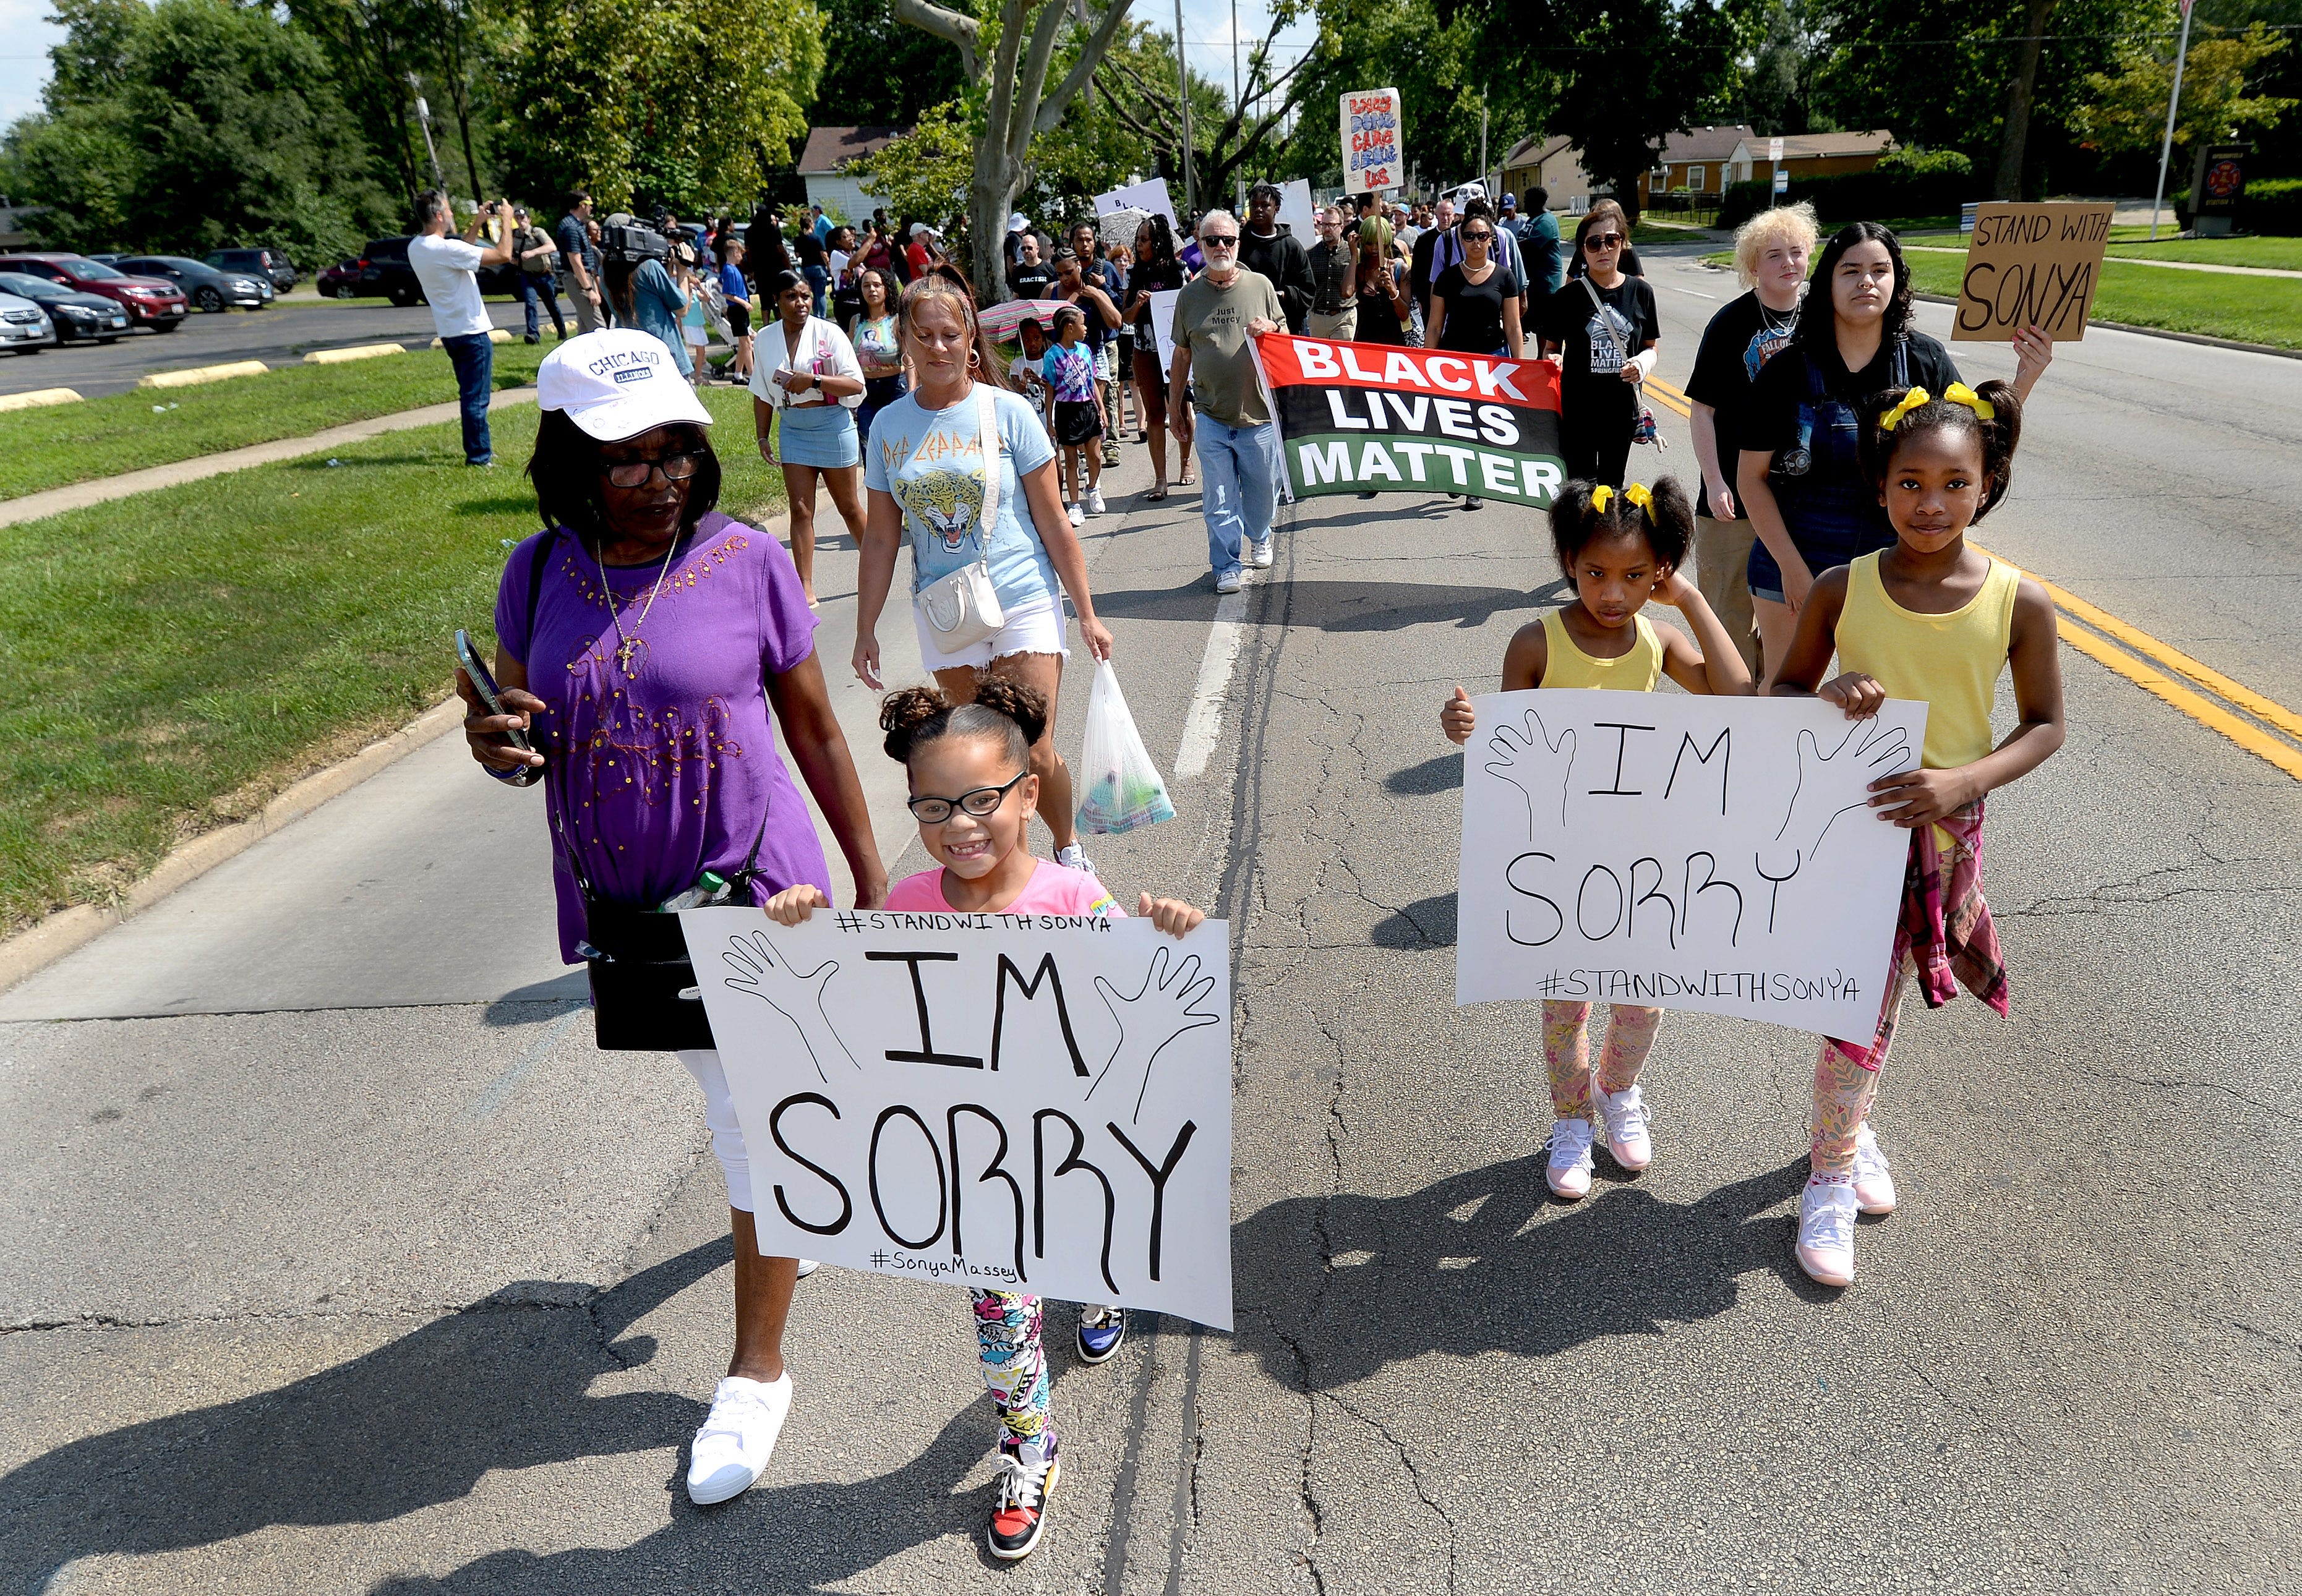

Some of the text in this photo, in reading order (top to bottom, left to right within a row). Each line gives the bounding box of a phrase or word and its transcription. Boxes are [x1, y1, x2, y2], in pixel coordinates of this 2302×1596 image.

[1977, 214, 2051, 246] STAND
[2060, 213, 2111, 242] WITH
[1212, 316, 1241, 325] Mercy
[1217, 307, 1234, 315] Just
[1959, 262, 2092, 335] SONYA
[589, 351, 659, 375] CHICAGO
[616, 369, 650, 383] ILLINOIS
[1292, 339, 1528, 401] BLACK
[1591, 349, 1624, 359] LIVE
[1325, 389, 1520, 445] LIVES
[882, 430, 1005, 471] DEF LEPPA
[1298, 441, 1562, 501] MATTER
[1588, 722, 1731, 816] IM
[1505, 848, 1801, 950] SORRY
[865, 950, 1090, 1078] IM
[769, 1091, 1197, 1295] SORRY
[870, 1248, 1017, 1284] #SonyaMassey
